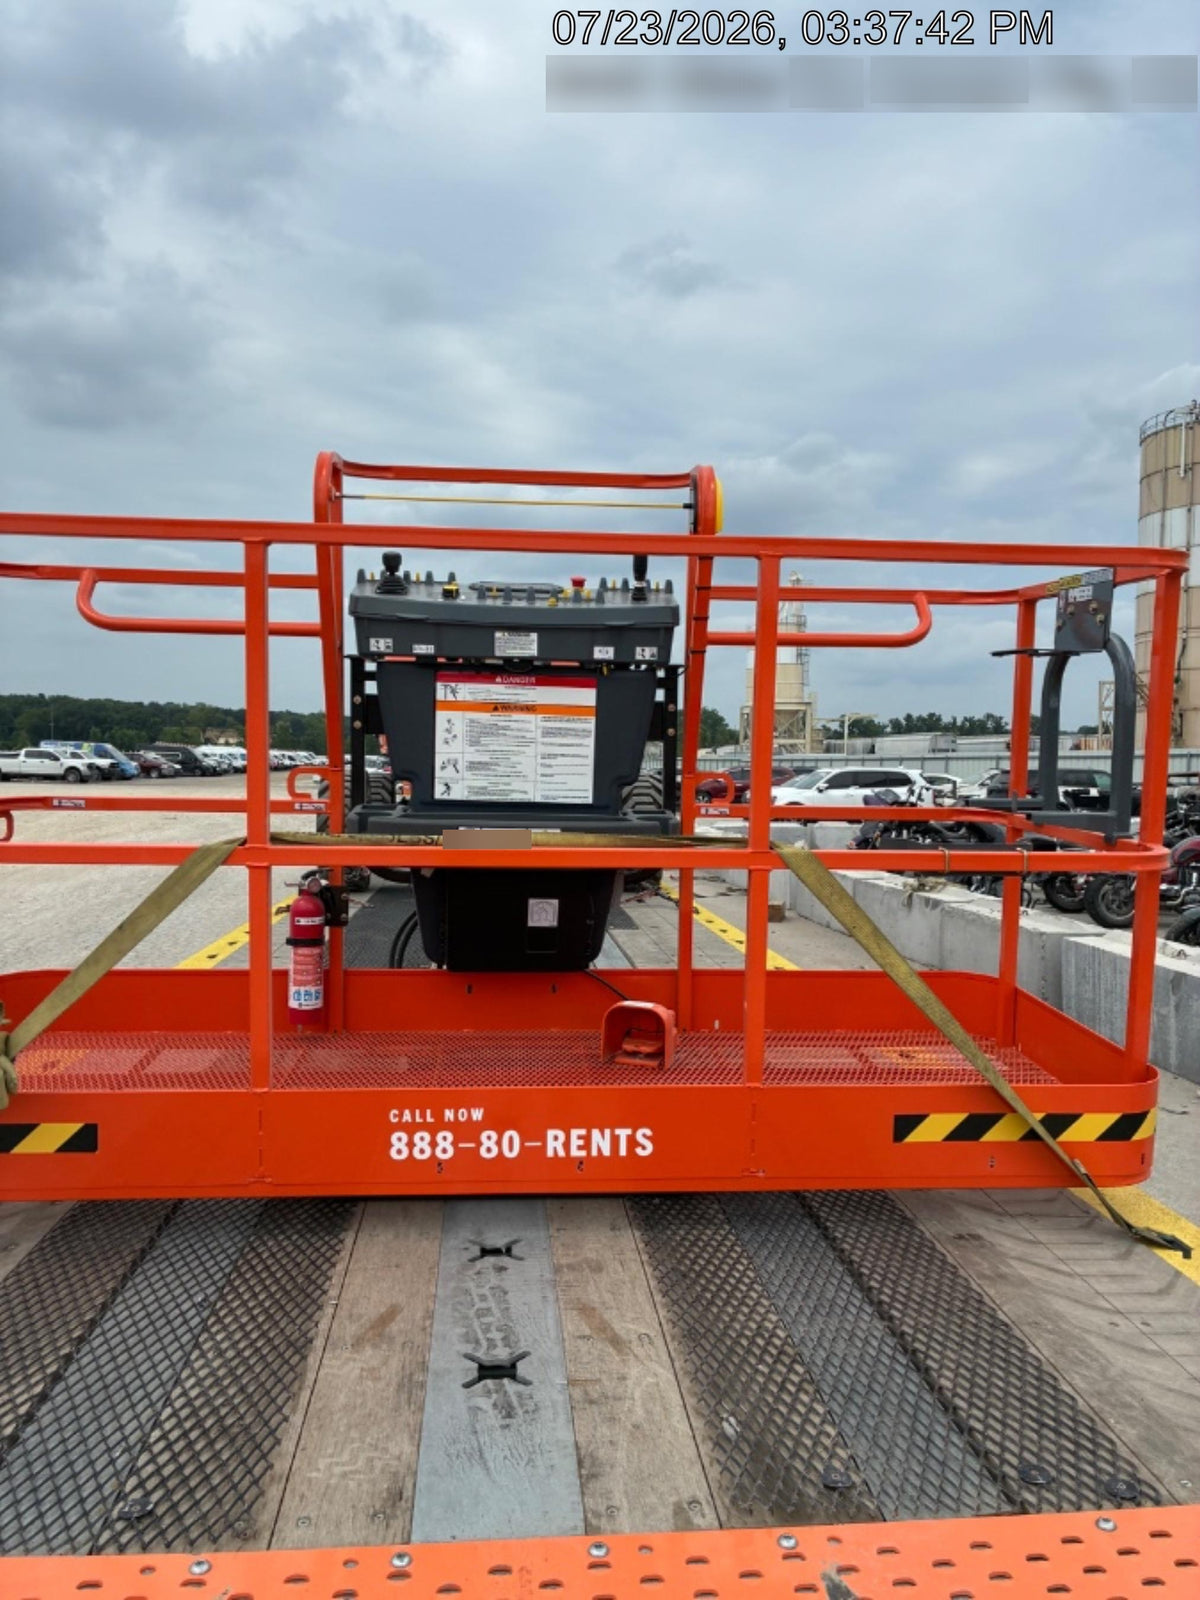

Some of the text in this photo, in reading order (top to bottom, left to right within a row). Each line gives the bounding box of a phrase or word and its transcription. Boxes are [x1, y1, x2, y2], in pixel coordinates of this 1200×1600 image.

[502, 675, 537, 684] DANGER
[389, 1107, 484, 1123] CALL NOW
[389, 1127, 654, 1161] 888-80-RENTS
